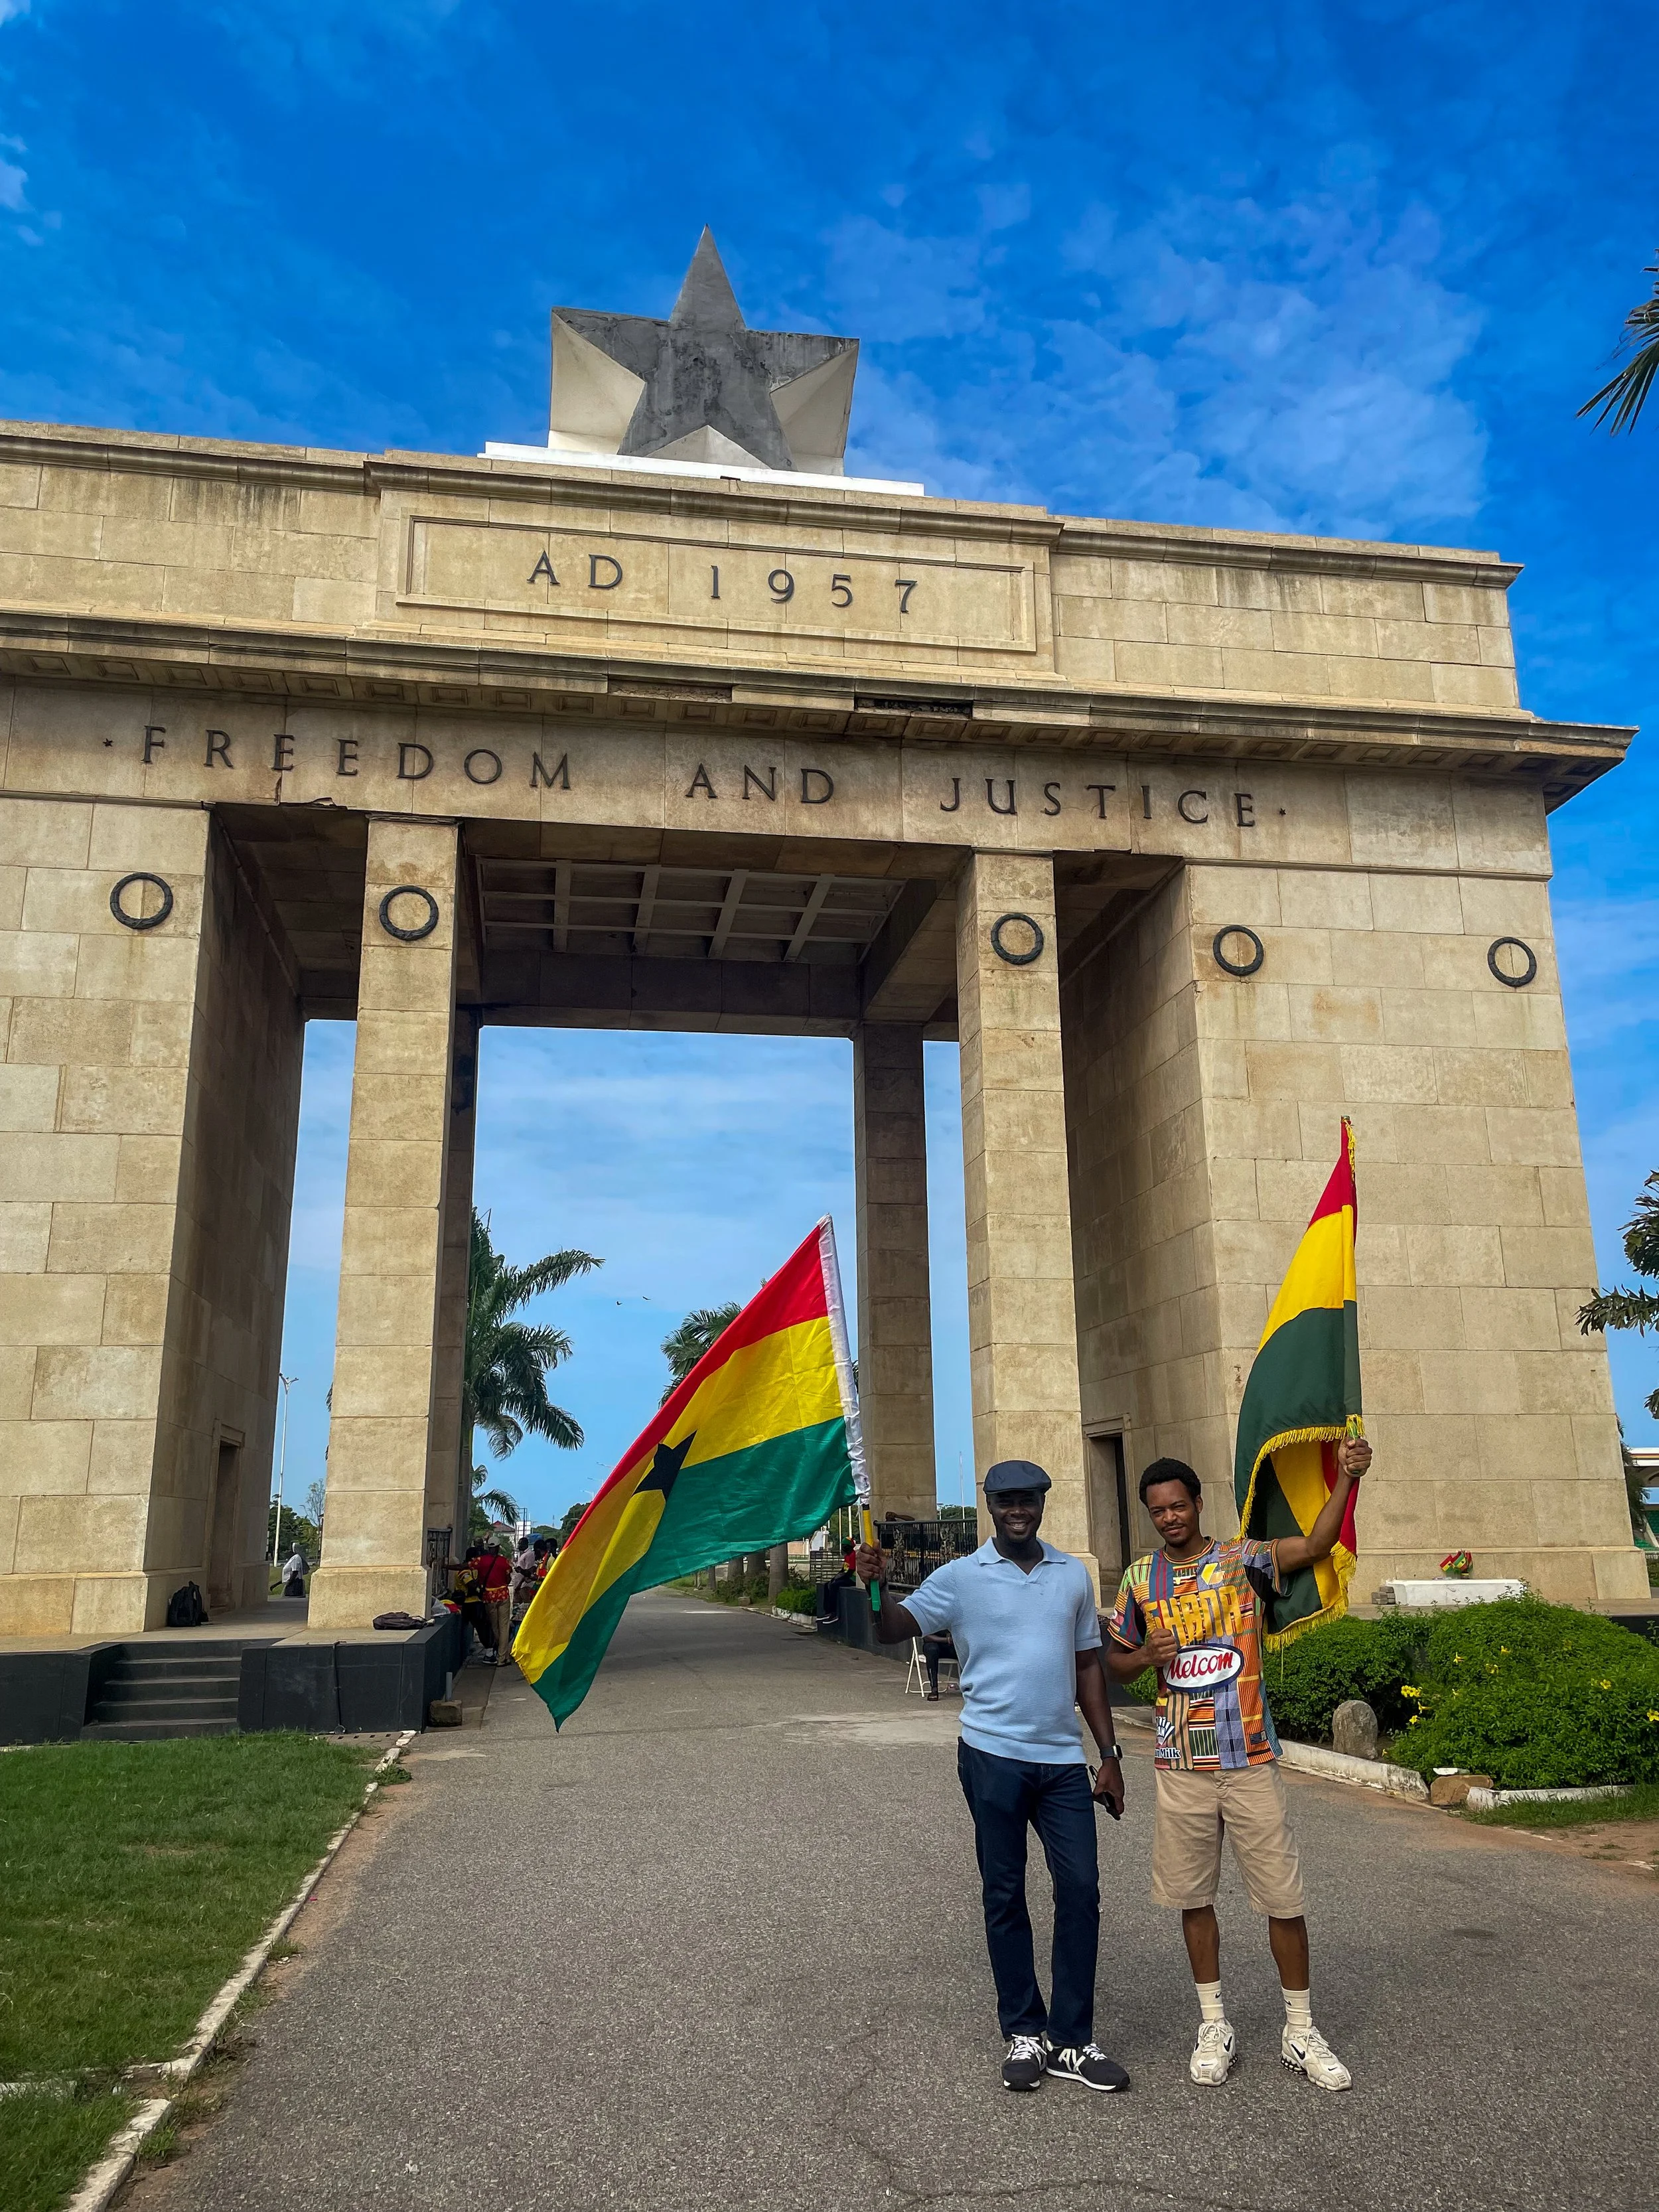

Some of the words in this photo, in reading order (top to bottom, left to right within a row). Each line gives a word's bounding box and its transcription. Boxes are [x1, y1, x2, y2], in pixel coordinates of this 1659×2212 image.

[526, 550, 623, 589] AD
[709, 565, 918, 614] 1957
[141, 725, 571, 790] FREEDOM
[684, 763, 834, 805] AND
[940, 777, 1256, 827] JUSTICE
[1166, 1652, 1234, 1680] Melcom
